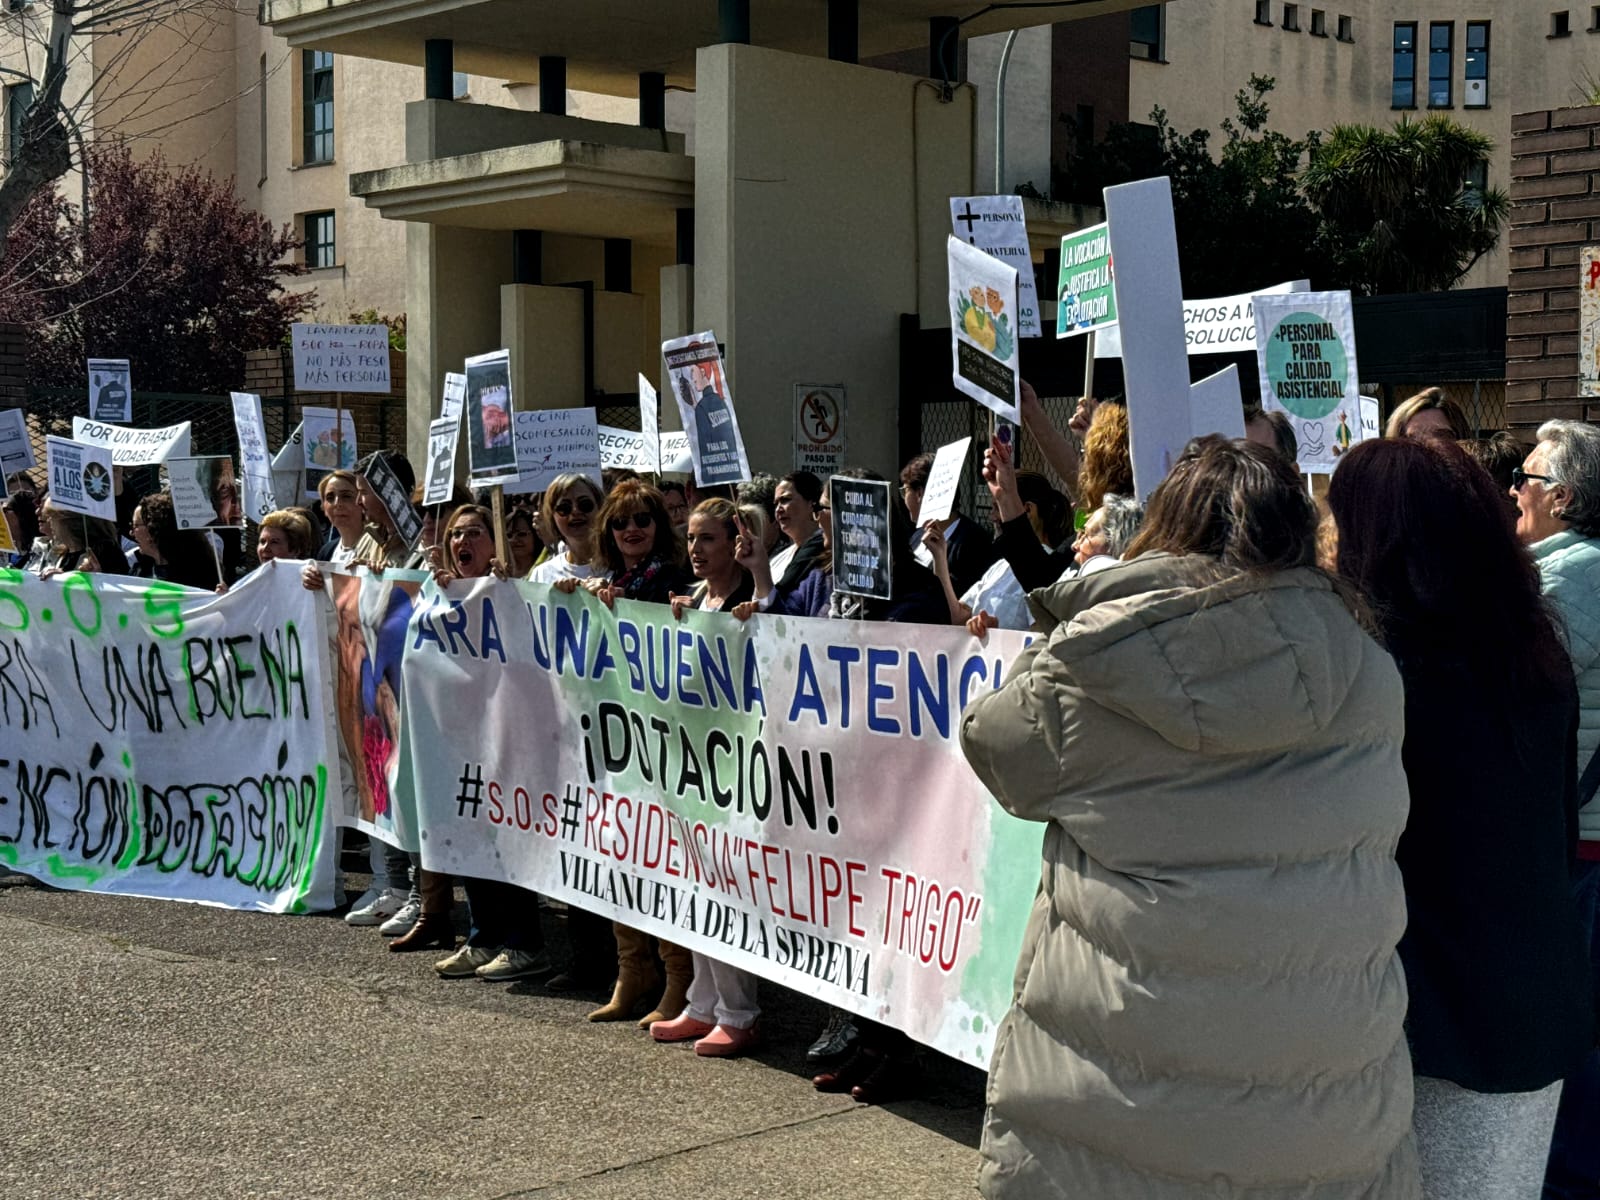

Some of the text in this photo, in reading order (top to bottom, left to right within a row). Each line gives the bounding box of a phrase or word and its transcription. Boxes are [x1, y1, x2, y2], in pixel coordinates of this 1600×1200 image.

[983, 213, 1023, 222] PERSONAL
[986, 247, 1027, 257] MATERIAL
[1065, 248, 1073, 268] LA
[1074, 234, 1106, 265] VOCACIÓN
[1068, 265, 1109, 297] JUSTIFICA LA
[1066, 292, 1109, 325] EXPLOTACIÓN
[1184, 306, 1228, 324] CHOS
[1229, 304, 1241, 320] A
[1275, 322, 1337, 341] +PERSONAL
[306, 352, 386, 368] NO MÁS PESO
[1292, 343, 1322, 361] PARA
[305, 368, 389, 384] MÁS PERSONAL
[1285, 361, 1332, 380] CALIDAD
[1276, 381, 1345, 399] ASISTENCIAL
[80, 423, 113, 440] POR
[113, 430, 135, 444] UN
[598, 433, 690, 450] RECHO MED
[113, 448, 158, 462] UDABLE
[797, 443, 842, 452] PROHIBIDO
[613, 452, 678, 466] SOLUÓN
[805, 454, 836, 463] PASO DE
[54, 467, 82, 490] A LOS
[845, 491, 874, 507] CUIDA AL
[841, 511, 872, 528] CUIDADOR
[843, 552, 879, 569] CUIDADO DE
[848, 572, 874, 589] CALIDAD
[413, 592, 1033, 739] ARA UNA BUENA ATENC
[70, 638, 187, 733] UNA
[182, 623, 310, 726] BUENA
[580, 702, 839, 835] ¡DOTACIÓN!
[559, 850, 872, 997] VILLANUEVA DE LA SERENA
[881, 868, 982, 972] TRIGO"
